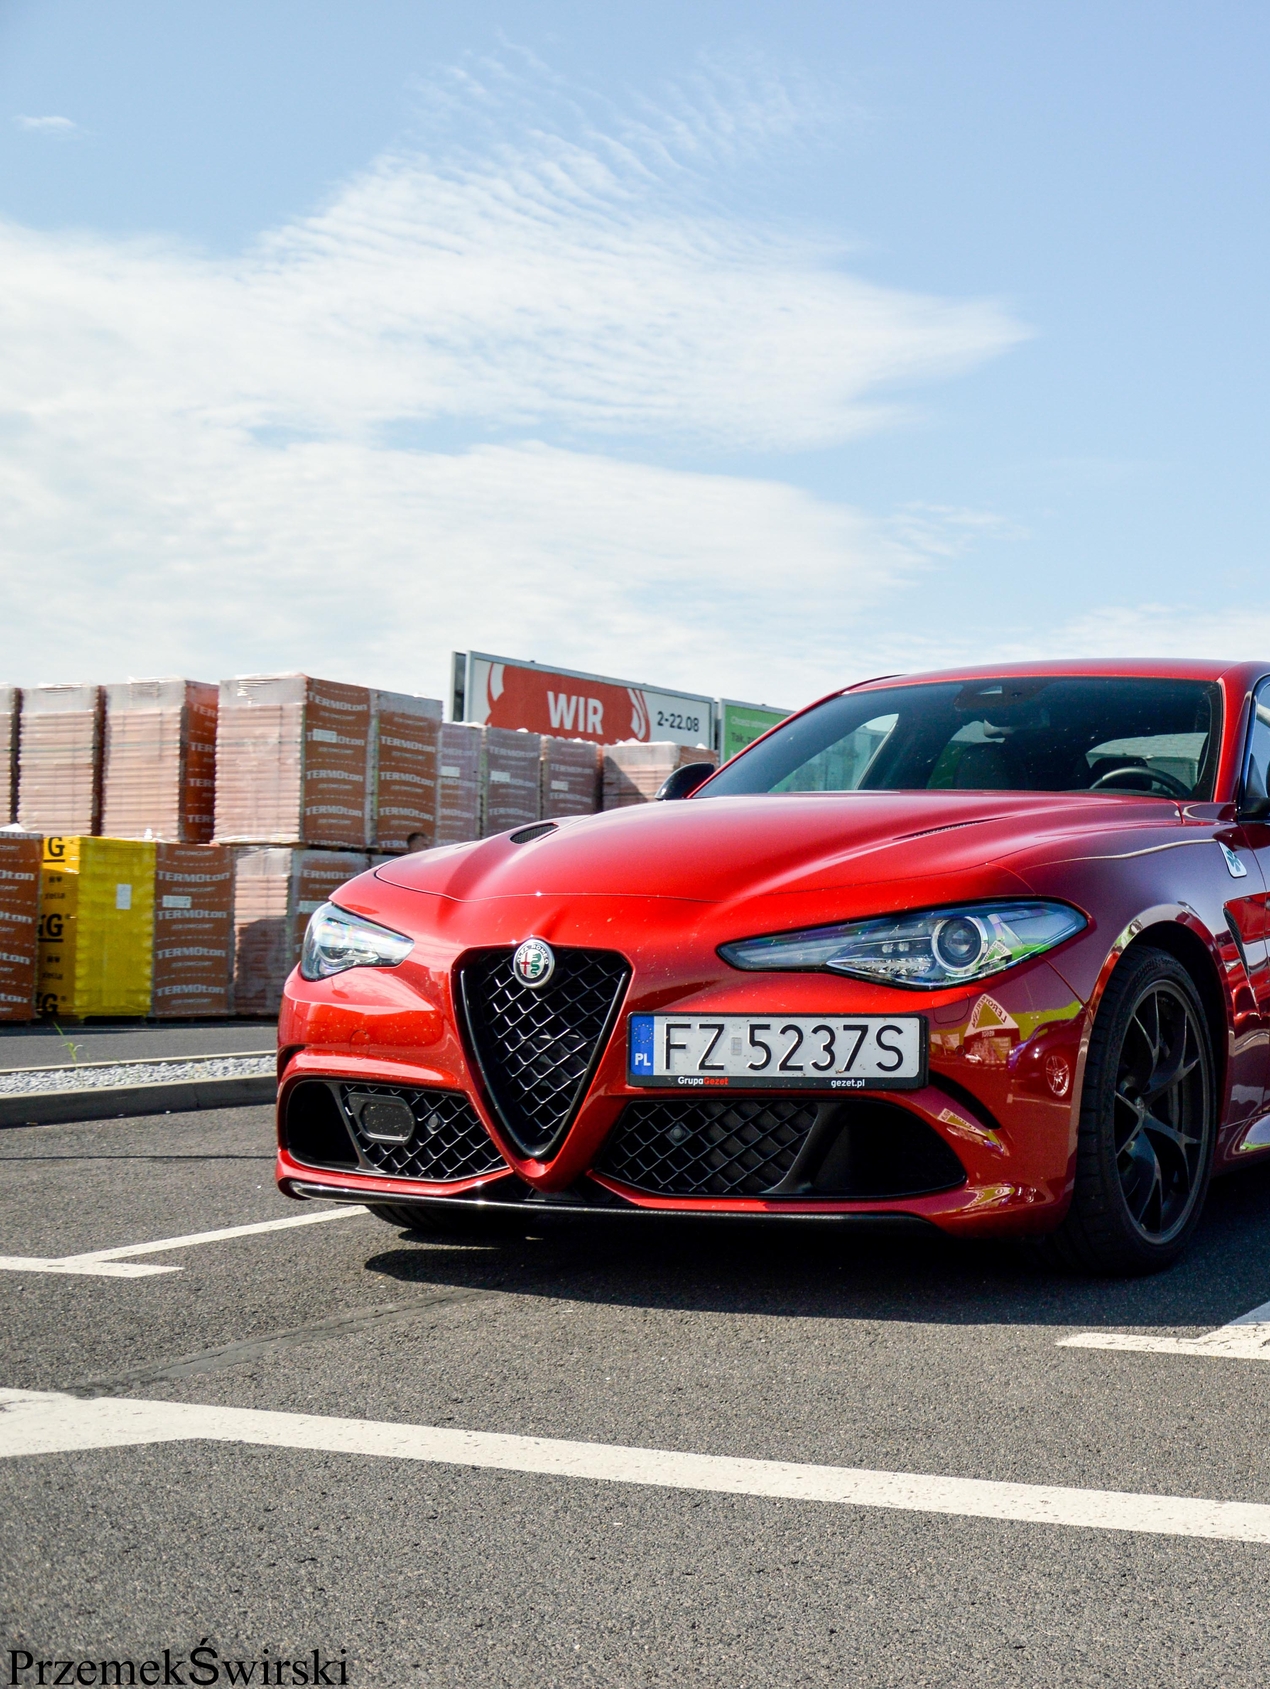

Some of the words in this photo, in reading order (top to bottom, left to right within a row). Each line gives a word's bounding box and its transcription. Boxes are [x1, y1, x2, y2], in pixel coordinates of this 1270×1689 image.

[547, 690, 604, 735] WIR
[657, 710, 700, 733] 2-22.08
[306, 731, 365, 747] TOton
[158, 871, 230, 883] TERMOton
[157, 910, 227, 921] TERMOton
[156, 947, 226, 959] TERMOton
[155, 984, 225, 997] TERMOton
[664, 1023, 725, 1071] FZ
[746, 1023, 905, 1072] 5237S
[634, 1053, 651, 1067] PL
[830, 1078, 866, 1089] gezet.pl
